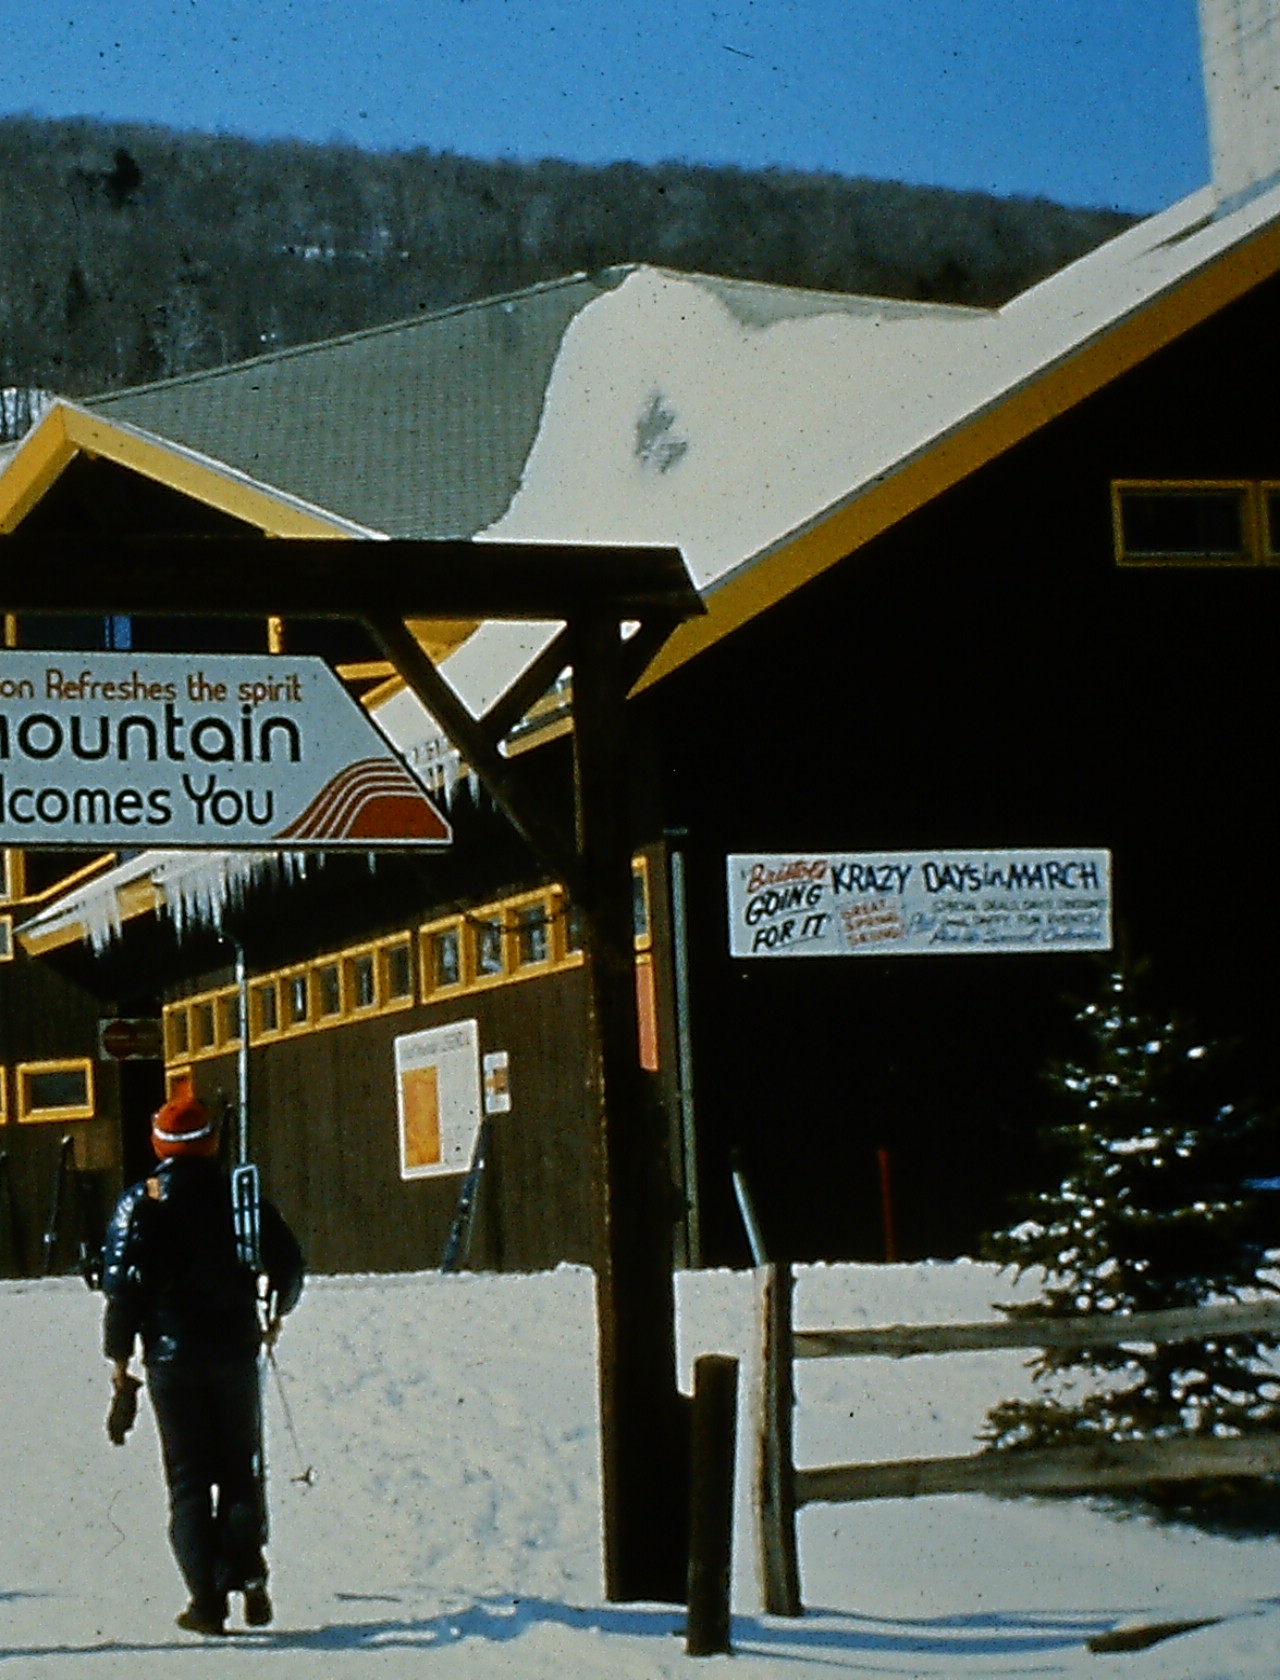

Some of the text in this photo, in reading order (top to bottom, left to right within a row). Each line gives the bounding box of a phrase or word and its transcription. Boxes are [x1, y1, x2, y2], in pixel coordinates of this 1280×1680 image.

[45, 668, 177, 700] Refreshes
[187, 671, 226, 701] the
[239, 674, 302, 706] spirit
[181, 773, 275, 826] You
[831, 862, 912, 895] KRAZY
[1007, 861, 1099, 890] MARCH
[746, 884, 824, 926] GOING
[752, 918, 794, 953] FOR
